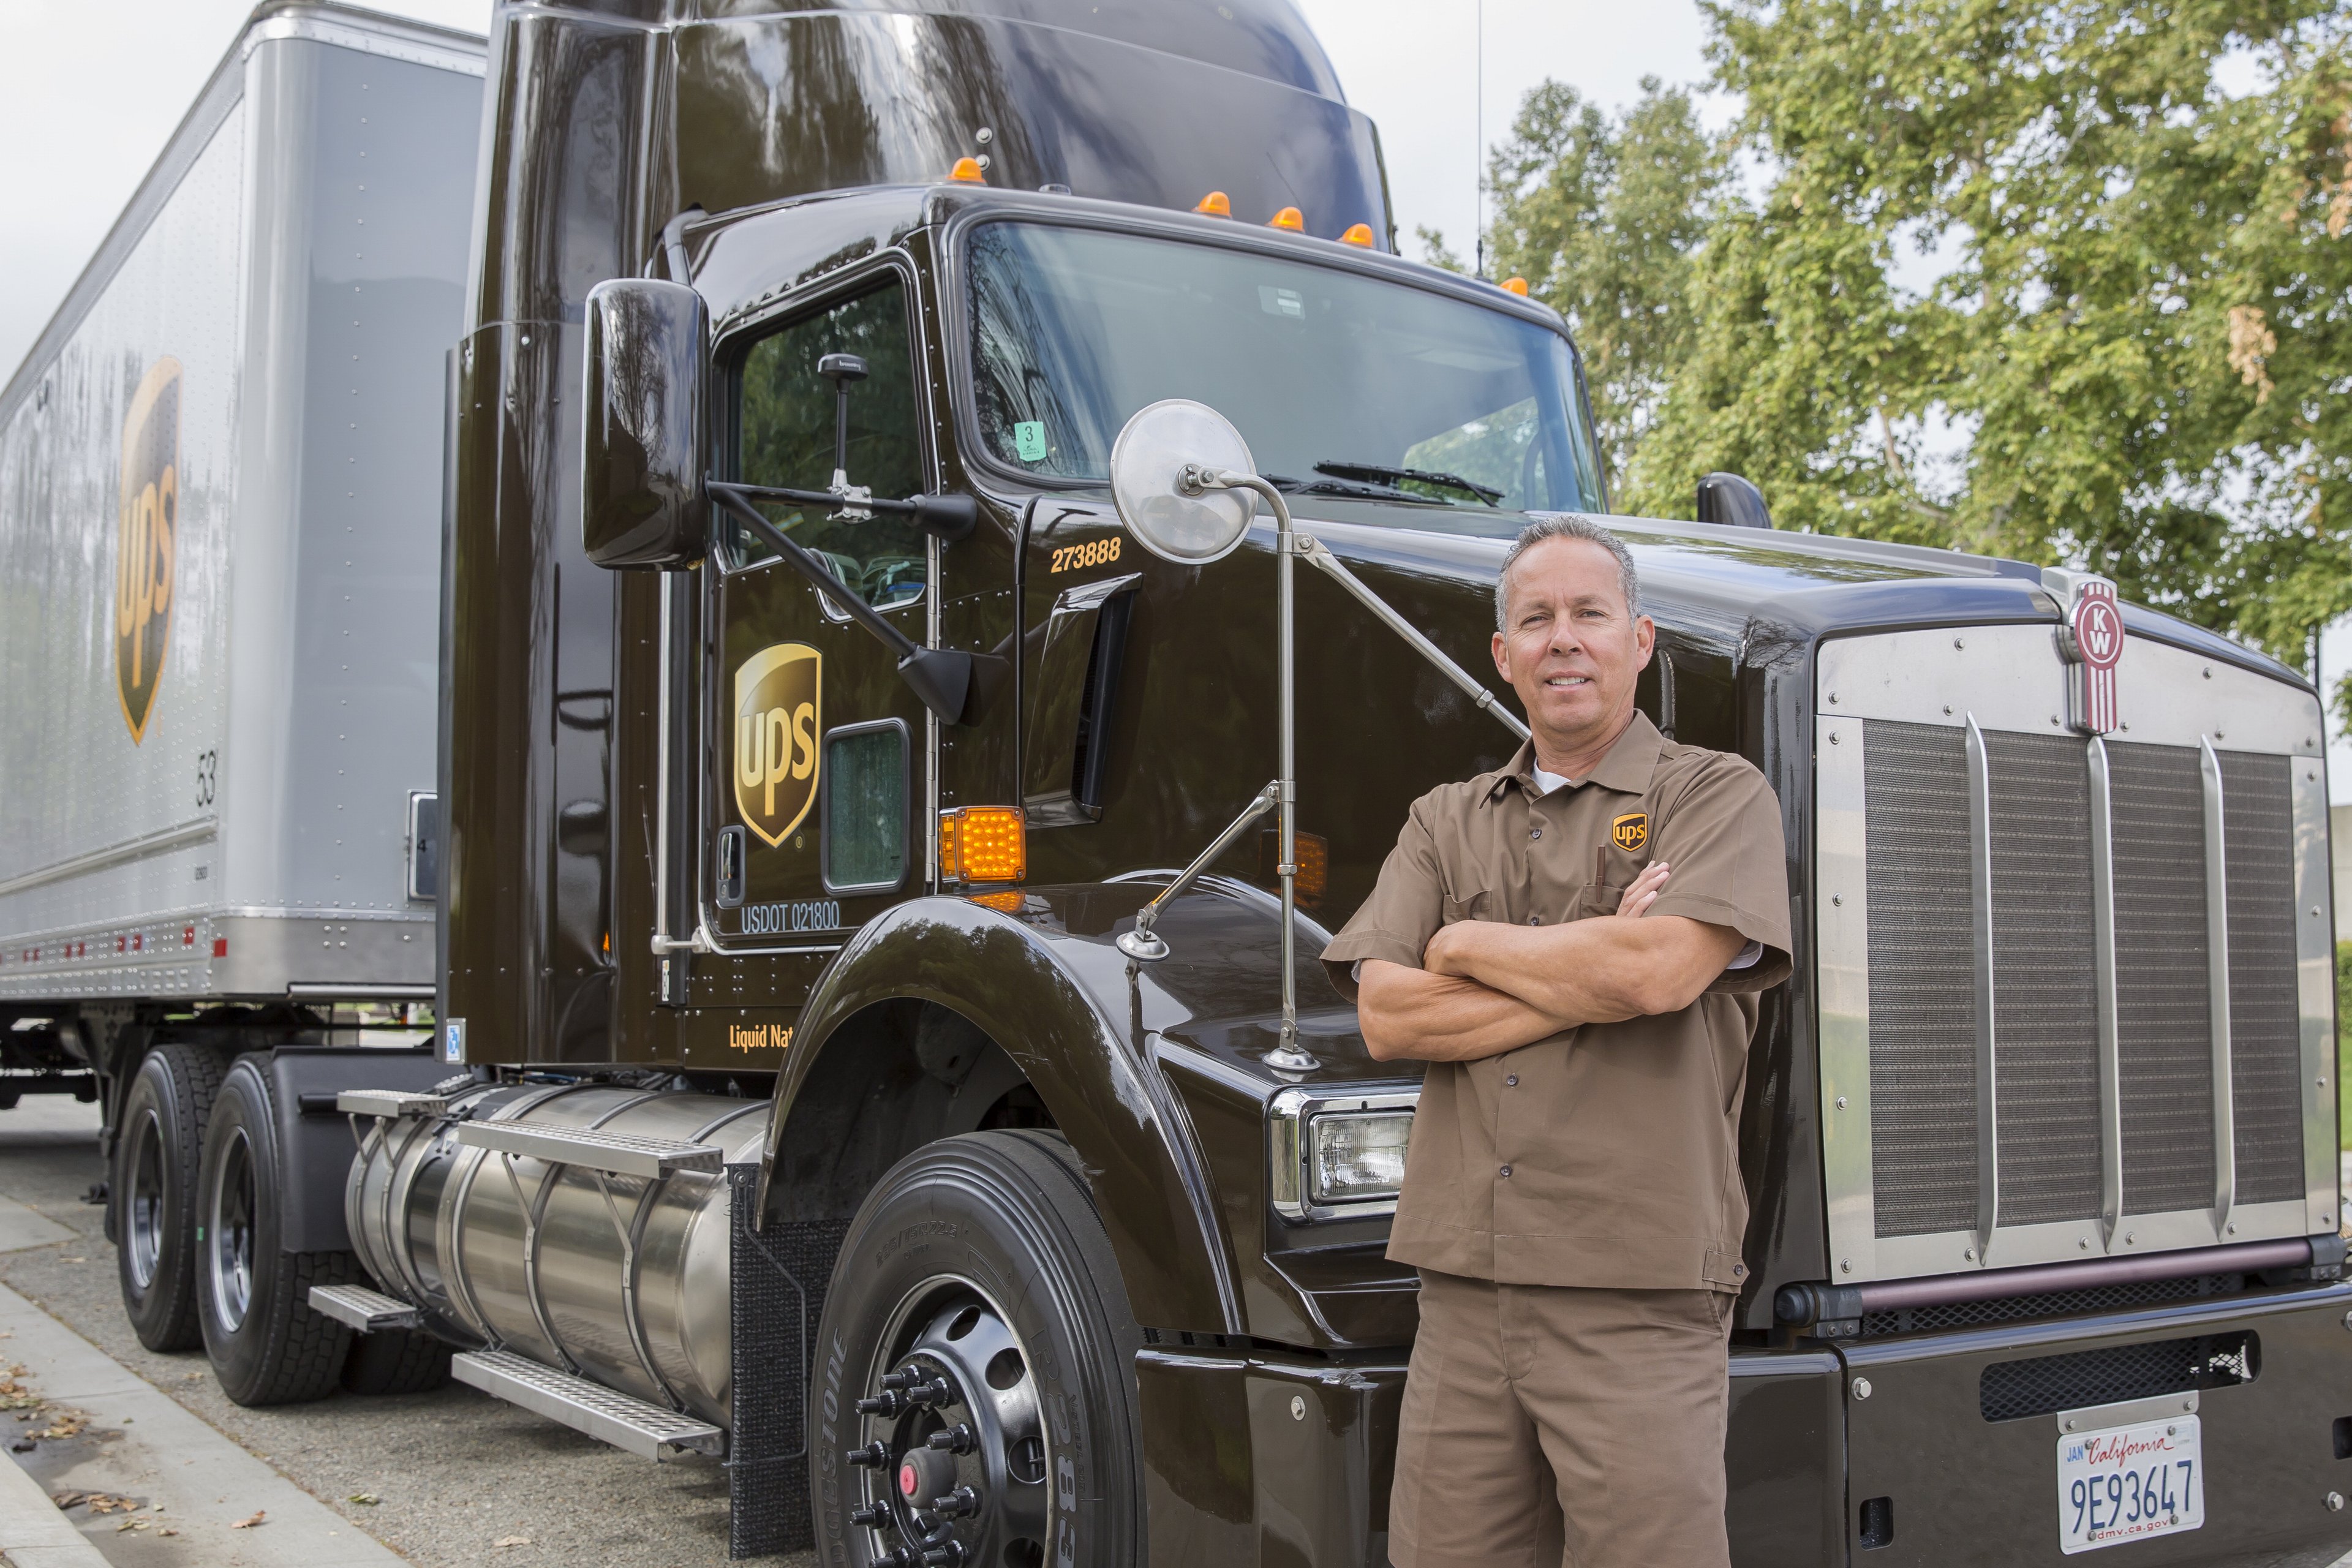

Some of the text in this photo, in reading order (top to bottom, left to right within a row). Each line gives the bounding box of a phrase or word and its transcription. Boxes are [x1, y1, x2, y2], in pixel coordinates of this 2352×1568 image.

[1025, 426, 1033, 442] 3
[1050, 537, 1121, 573] 273888
[121, 464, 175, 688] ups
[741, 702, 815, 816] ups
[1616, 824, 1645, 846] ups
[741, 900, 840, 934] USDOT 021800
[729, 1024, 767, 1054] Liquid
[2067, 1444, 2083, 1463] JAN
[2089, 1434, 2174, 1468] California
[2071, 1459, 2192, 1534] 9E93647
[2097, 1518, 2168, 1540] dmv.ca.gov
